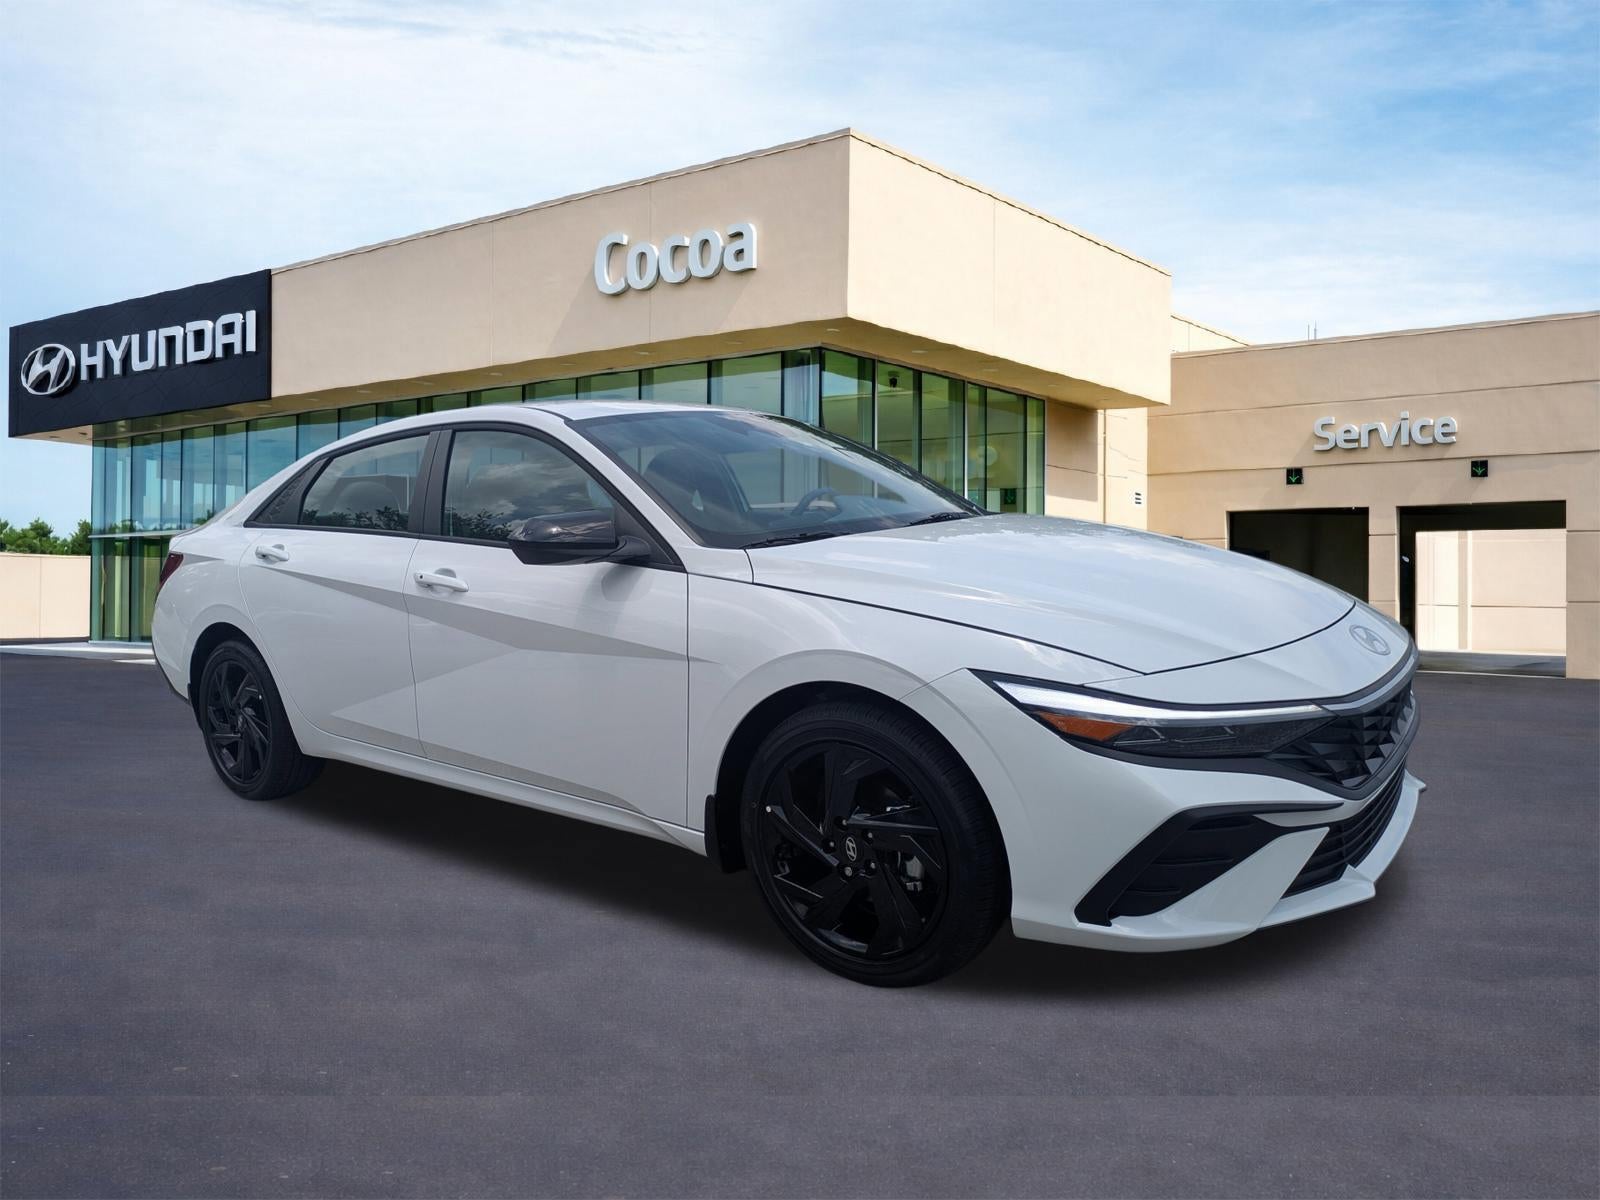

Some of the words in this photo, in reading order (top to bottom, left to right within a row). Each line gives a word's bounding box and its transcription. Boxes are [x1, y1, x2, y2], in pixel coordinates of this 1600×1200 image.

[594, 223, 757, 295] Cocoa
[80, 310, 256, 381] HYUNDAI
[1313, 411, 1458, 451] Service
